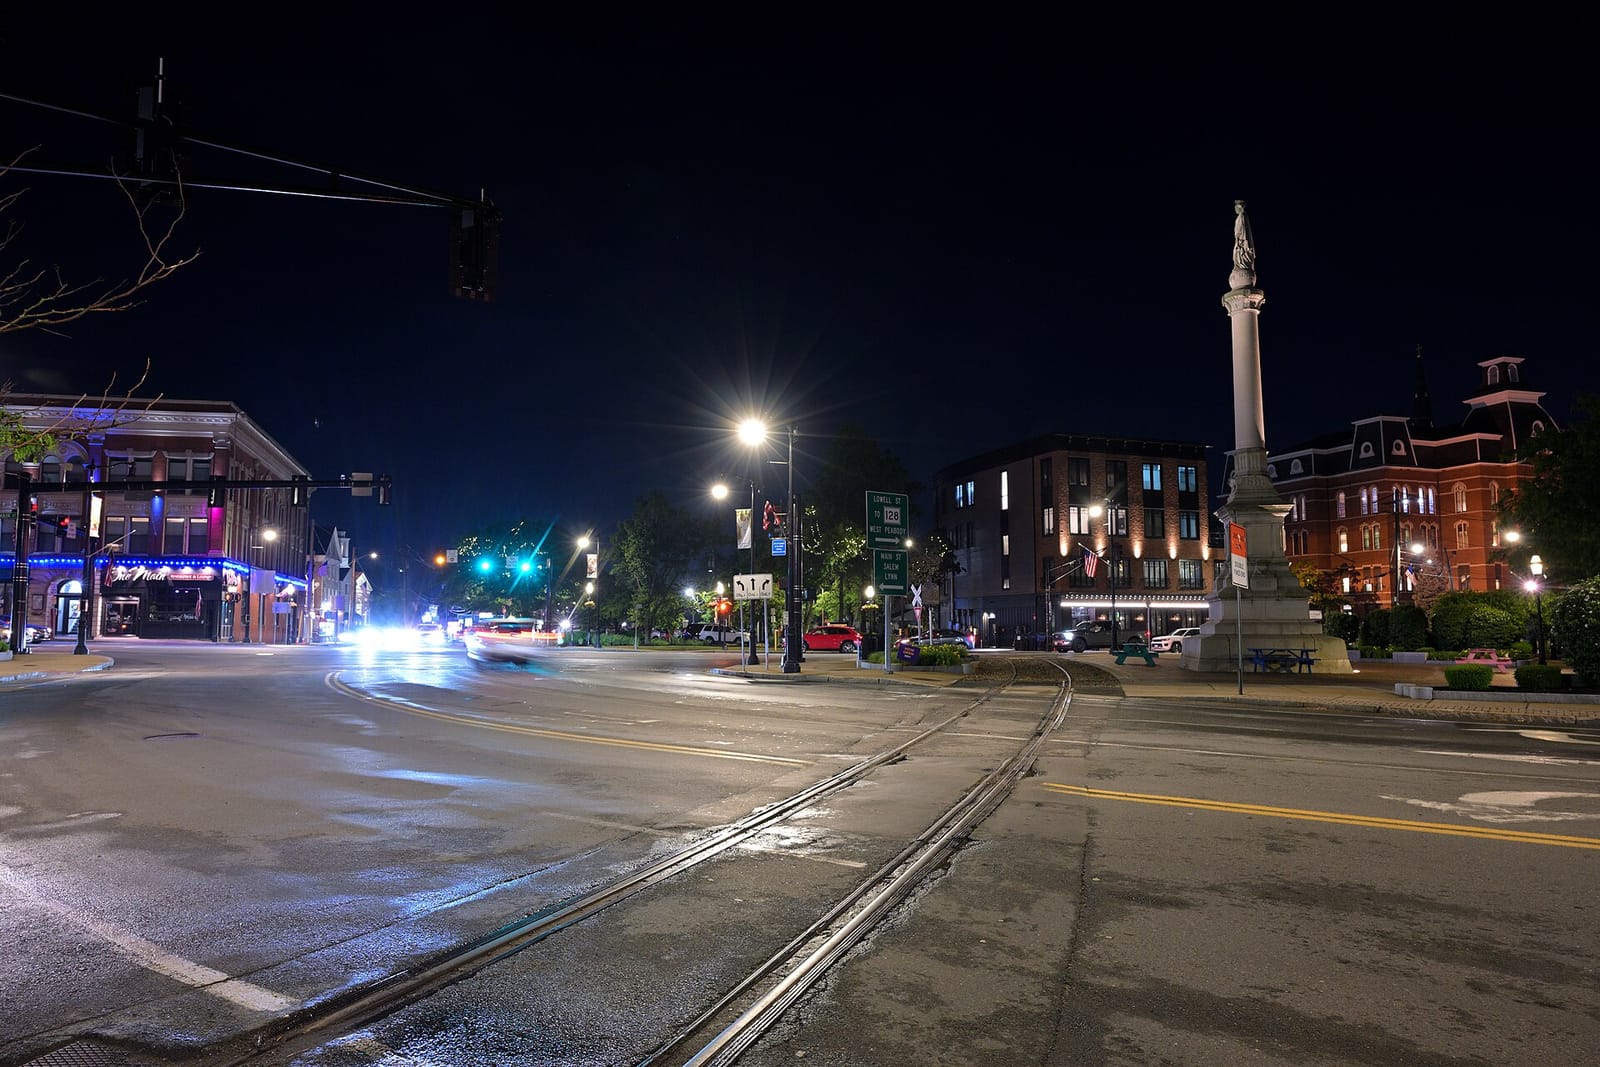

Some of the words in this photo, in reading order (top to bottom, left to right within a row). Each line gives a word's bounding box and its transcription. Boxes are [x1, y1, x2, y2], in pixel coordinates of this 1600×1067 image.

[873, 496, 892, 504] LOWELL
[885, 510, 899, 521] 128
[884, 526, 906, 535] PEABODY
